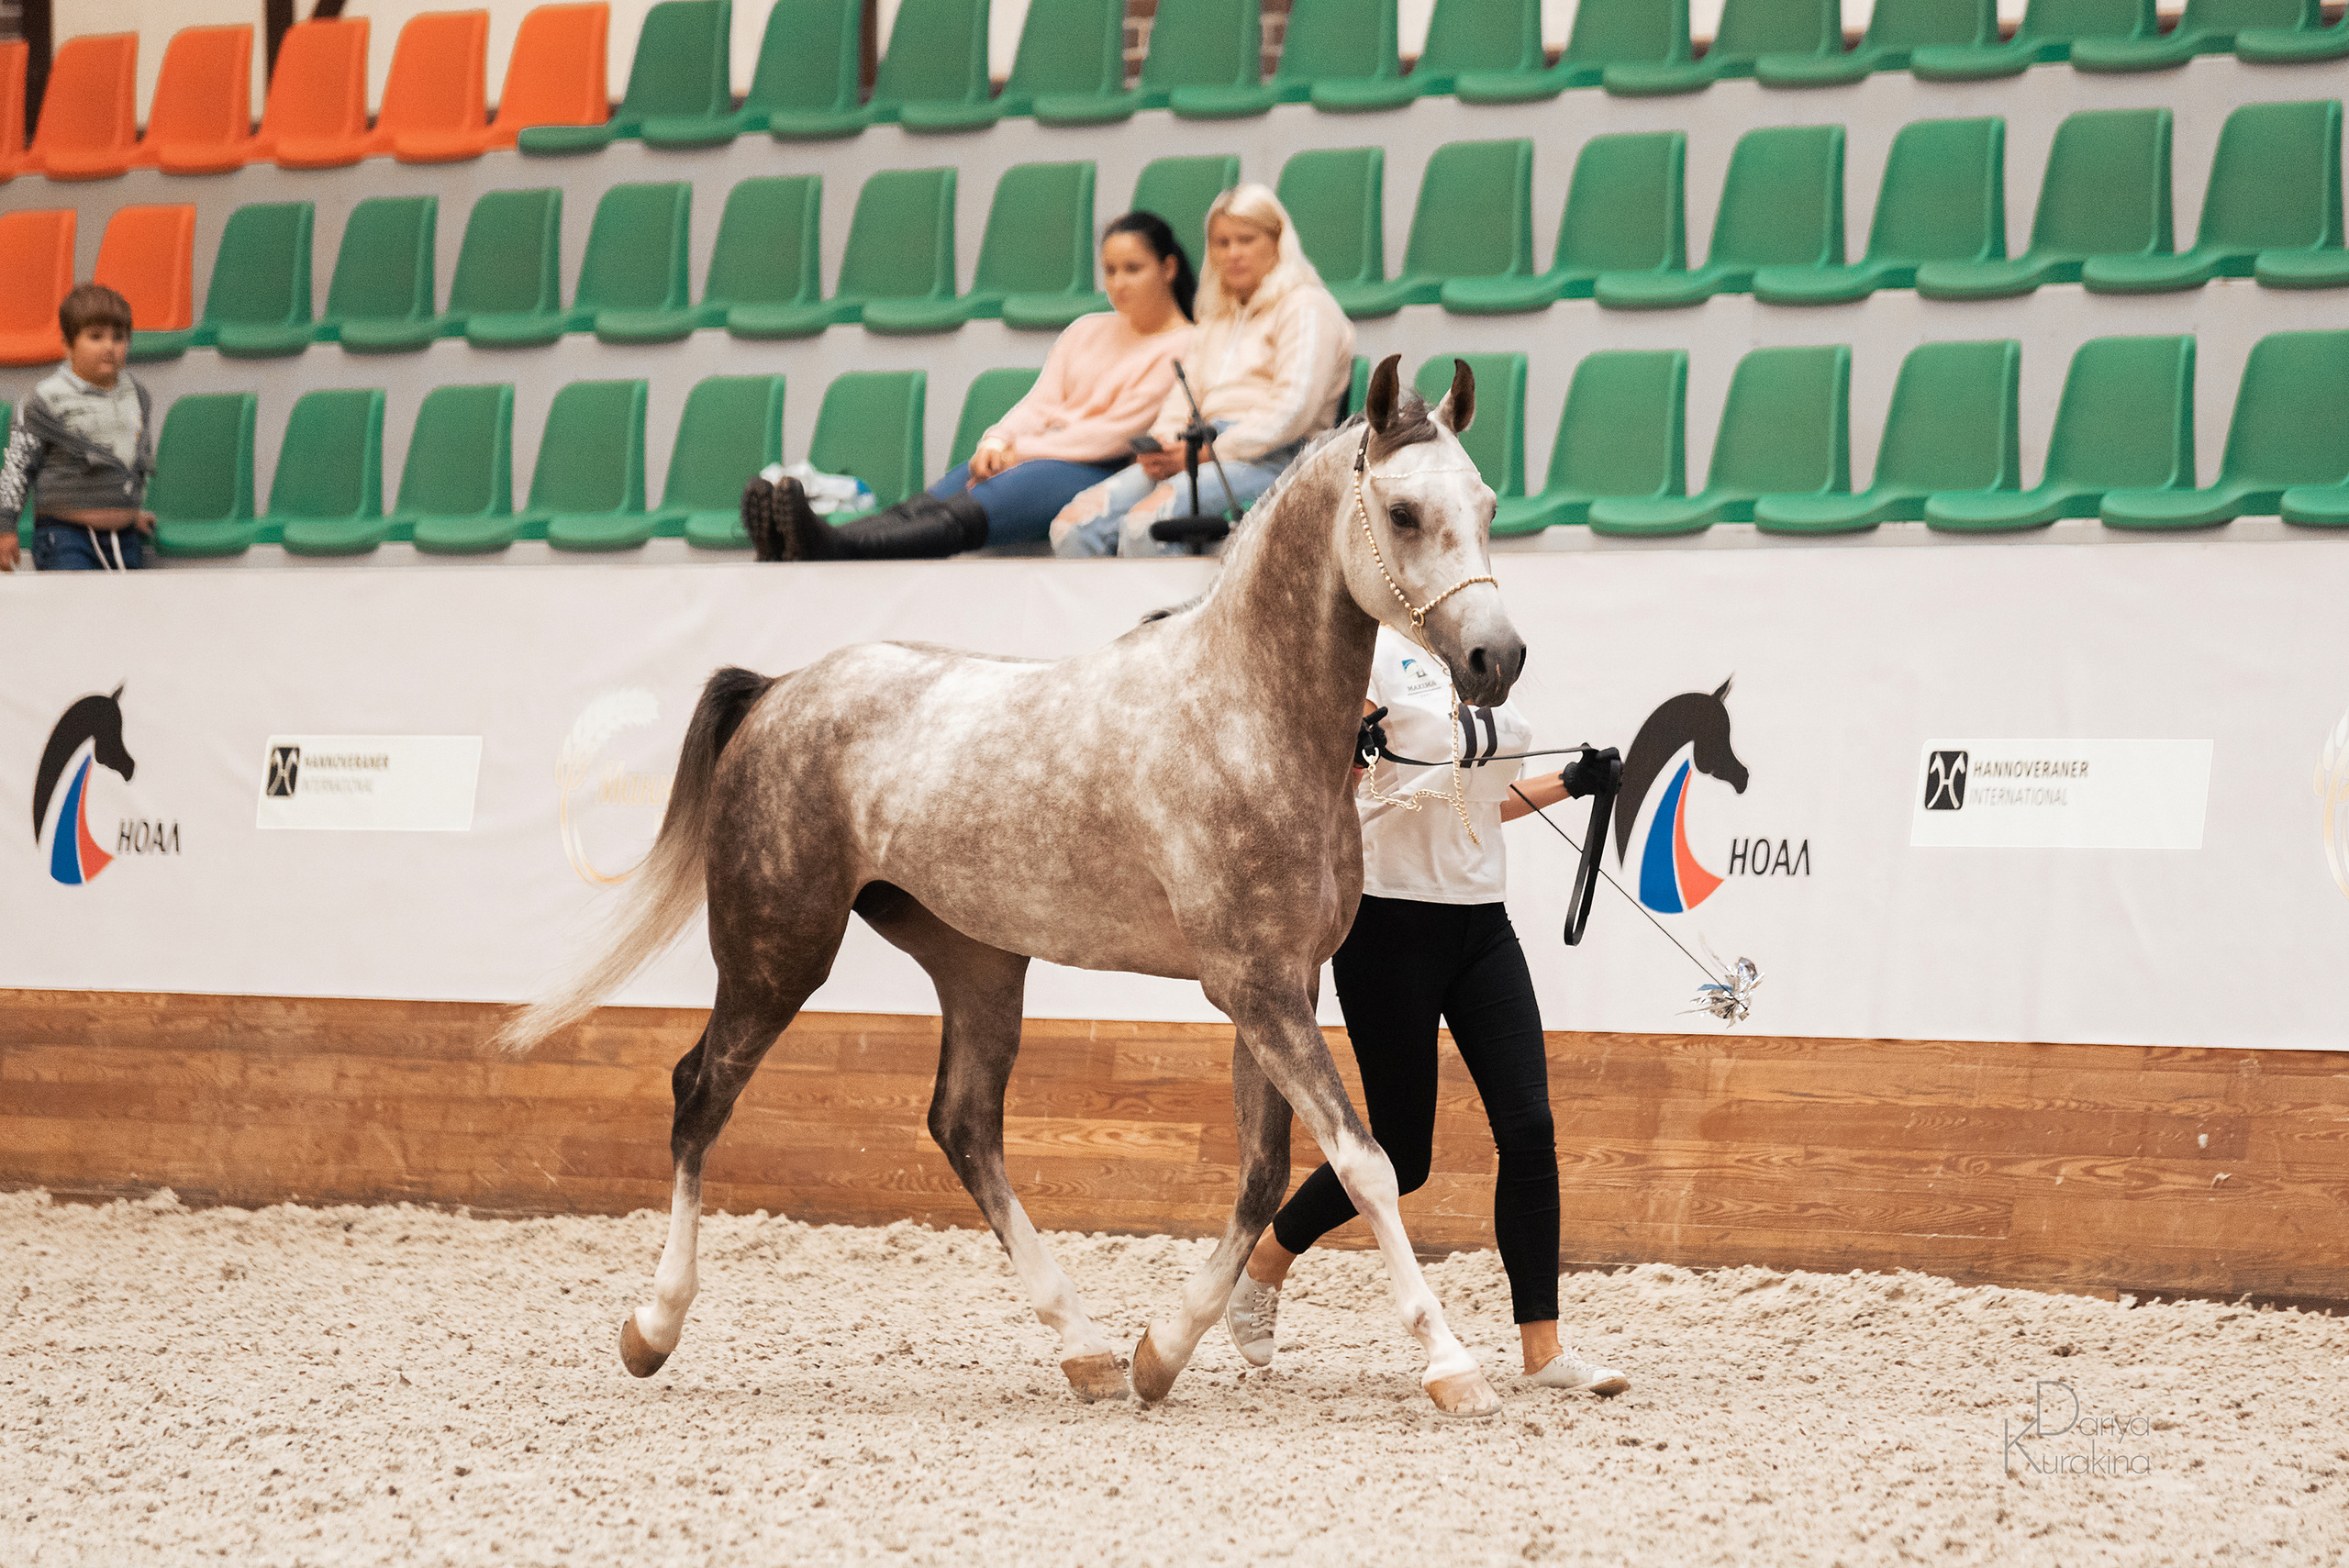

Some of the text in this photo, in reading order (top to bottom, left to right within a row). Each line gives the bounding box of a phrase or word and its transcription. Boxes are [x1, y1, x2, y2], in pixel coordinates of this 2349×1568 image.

[1973, 760, 2089, 778] HANNOVERANER
[1969, 787, 2068, 806] INTERNATIONAL
[1729, 838, 1810, 875] НОАЛ
